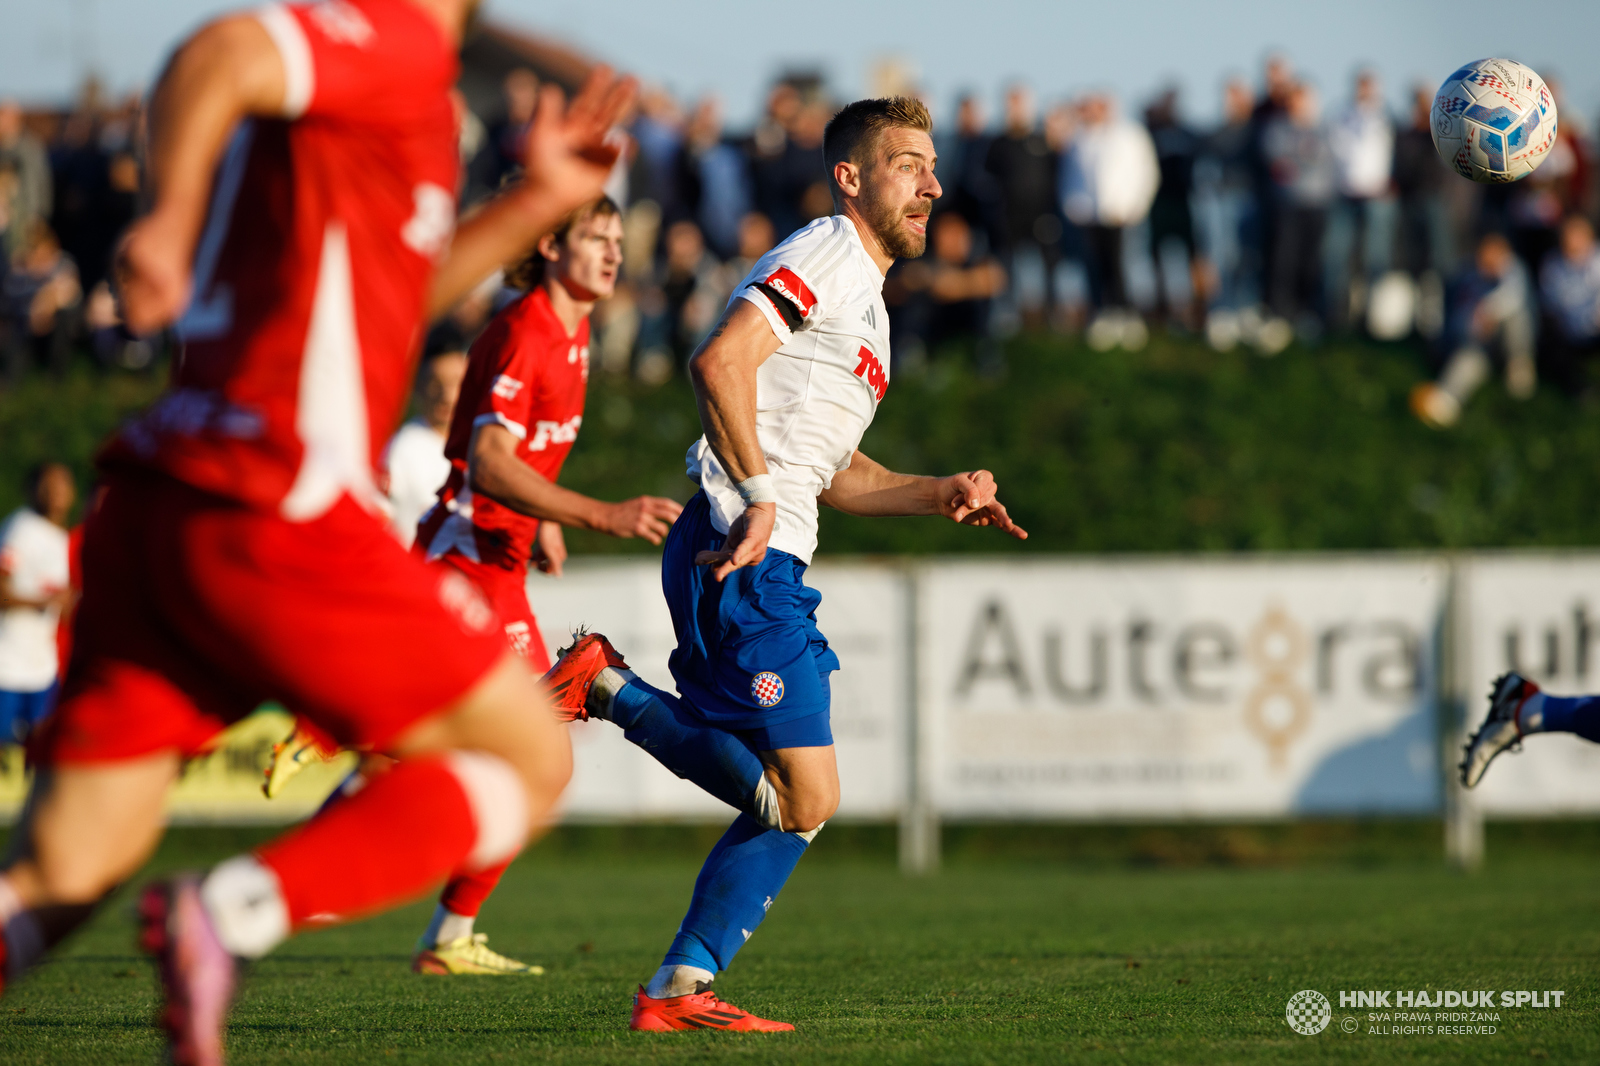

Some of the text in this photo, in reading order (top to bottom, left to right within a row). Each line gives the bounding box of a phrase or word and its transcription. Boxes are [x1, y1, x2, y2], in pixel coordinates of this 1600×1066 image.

[1493, 62, 1516, 87] uhlsport
[752, 673, 778, 688] HAJDUK
[758, 694, 780, 706] SPLIT
